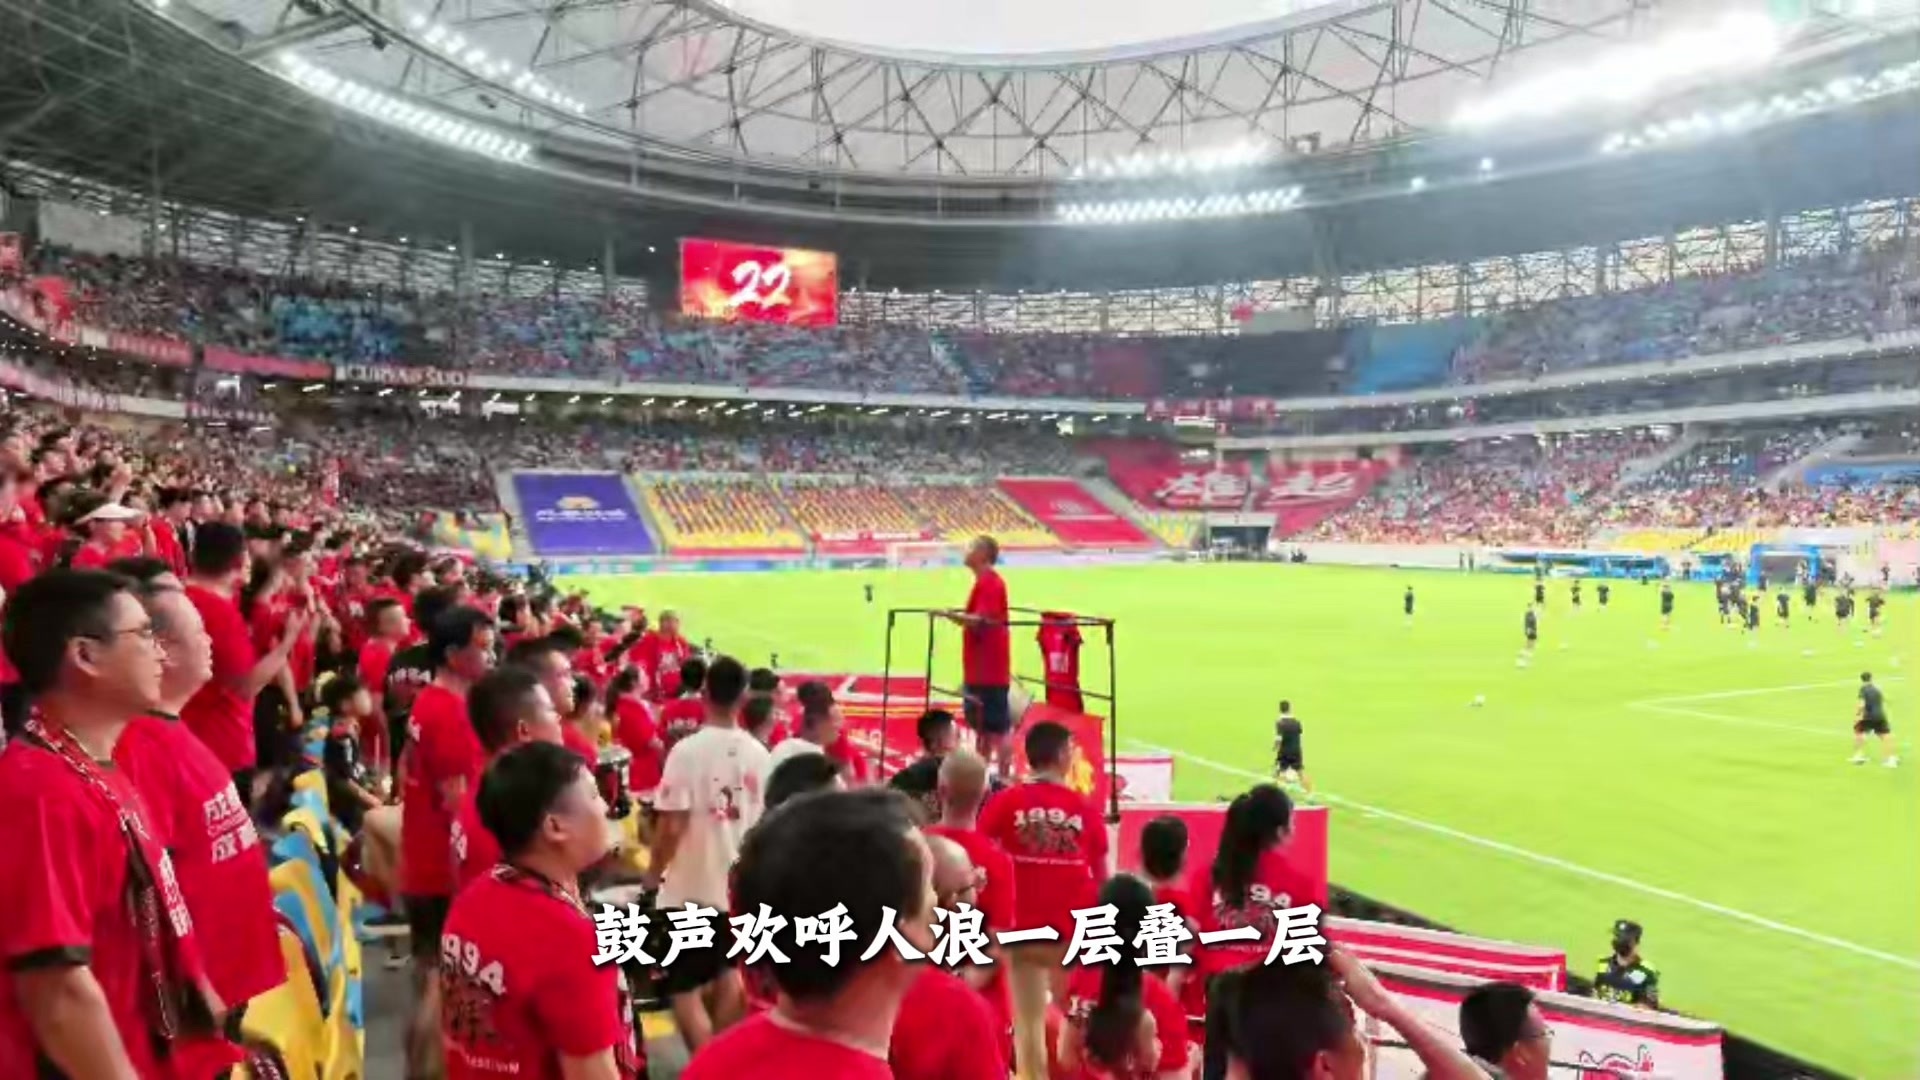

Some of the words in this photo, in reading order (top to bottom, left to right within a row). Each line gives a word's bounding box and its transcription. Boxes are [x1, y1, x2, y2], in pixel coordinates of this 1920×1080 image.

[728, 260, 791, 309] 22
[1013, 807, 1083, 831] 1994
[1212, 884, 1292, 909] 194
